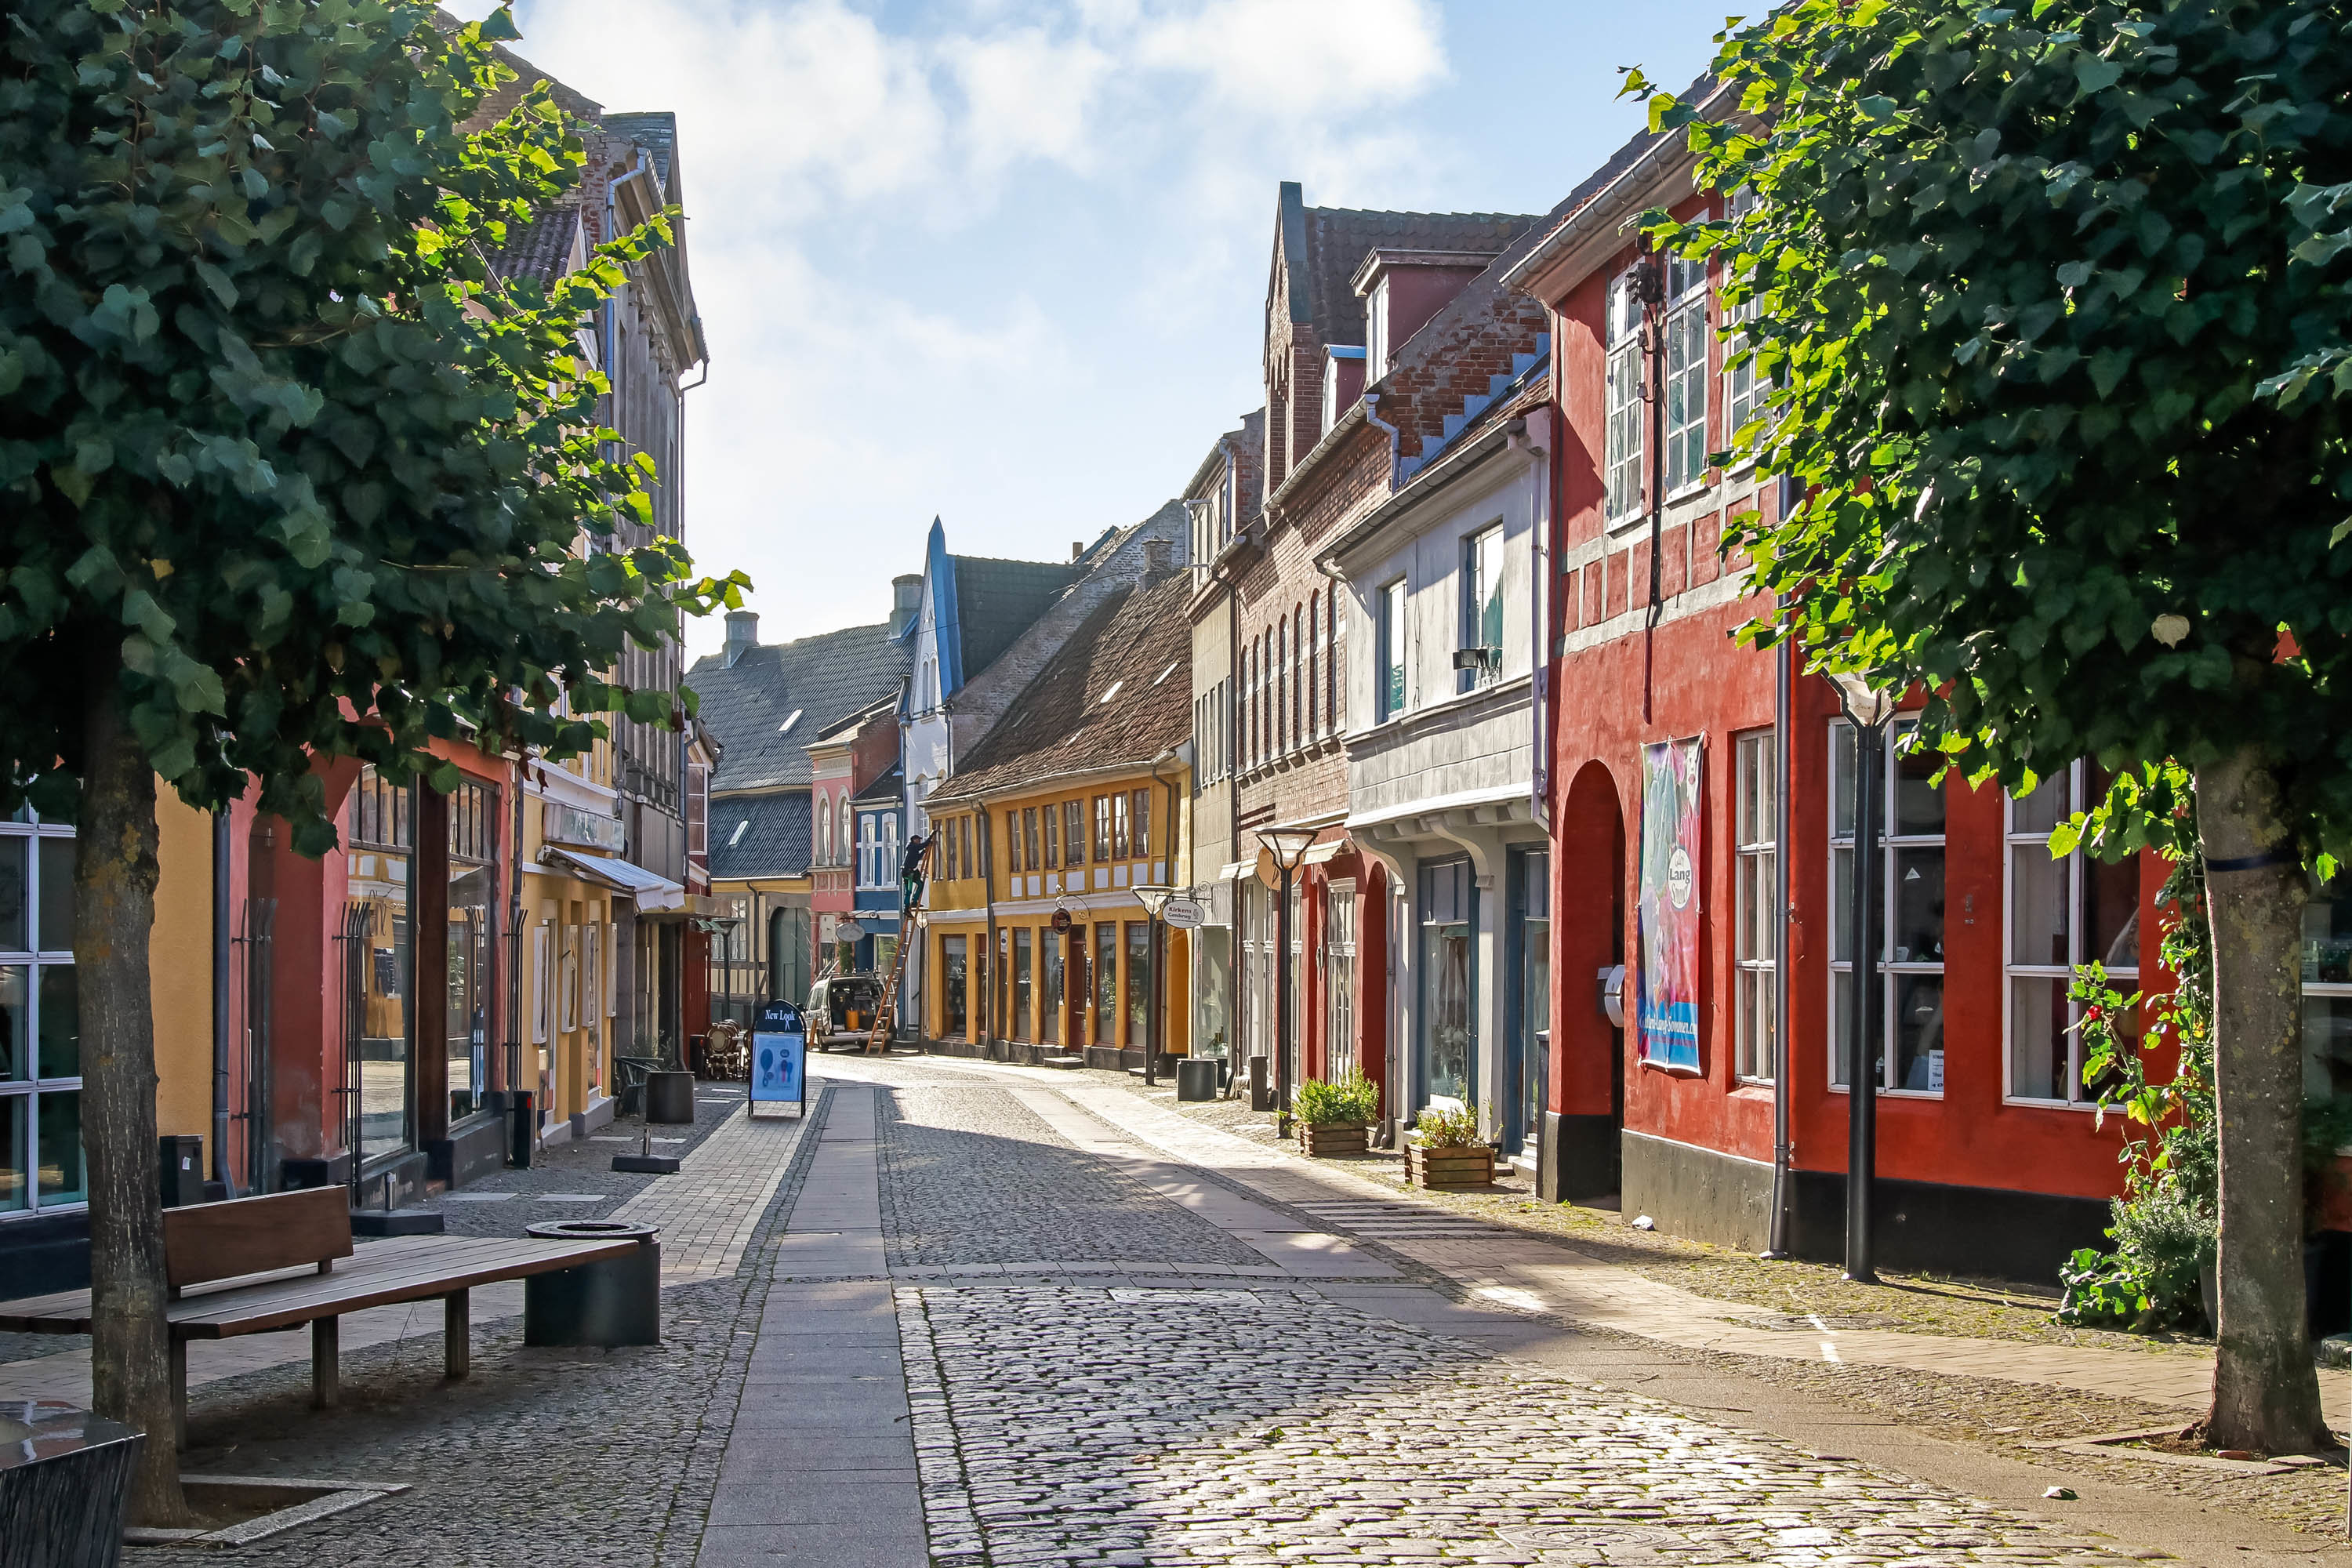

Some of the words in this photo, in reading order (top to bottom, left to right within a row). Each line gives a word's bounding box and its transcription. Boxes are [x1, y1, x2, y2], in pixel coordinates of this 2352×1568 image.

[1669, 868, 1690, 884] Lang
[765, 1009, 779, 1020] New
[779, 1009, 795, 1021] Look
